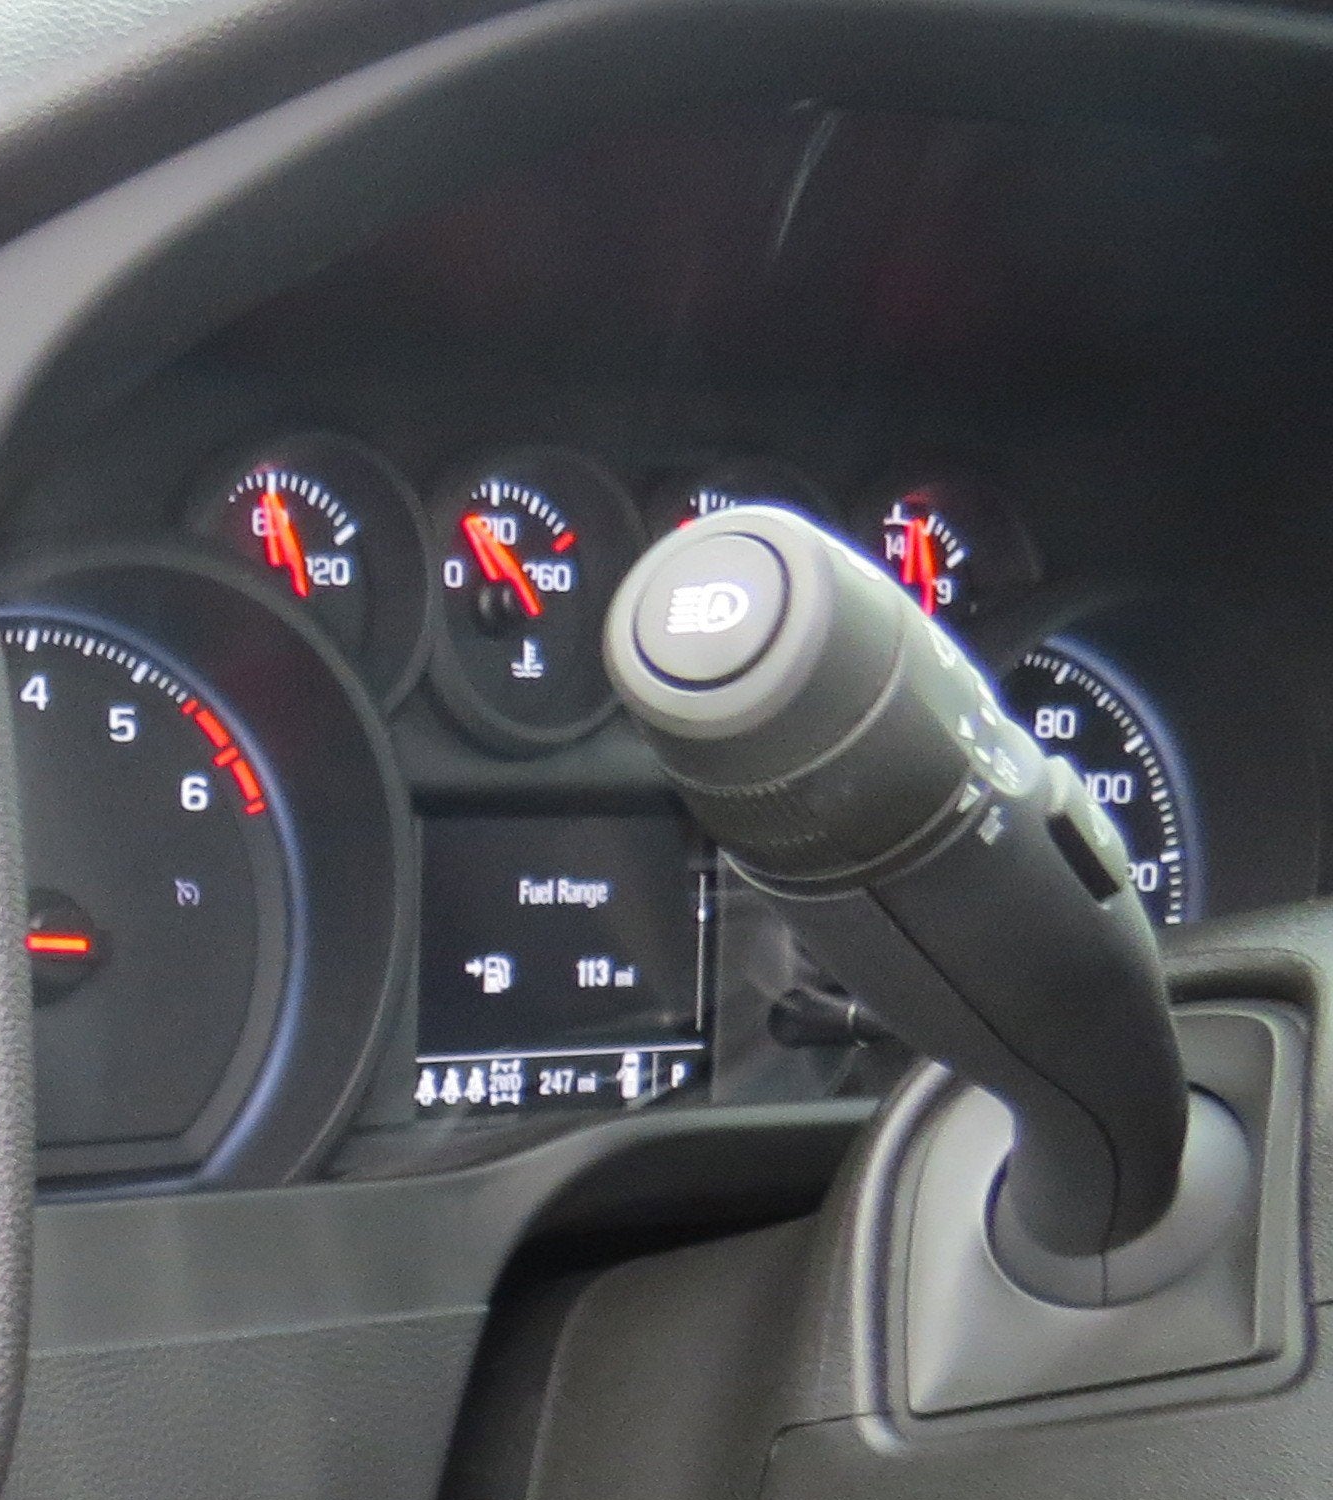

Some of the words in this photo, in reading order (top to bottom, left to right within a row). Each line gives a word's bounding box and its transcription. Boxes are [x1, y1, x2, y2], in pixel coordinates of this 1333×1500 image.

[443, 558, 464, 589] 0
[19, 673, 49, 711] 4
[108, 706, 137, 743] 5
[1034, 707, 1077, 740] 80
[180, 775, 209, 812] 6
[518, 879, 553, 905] Fuel
[558, 879, 608, 908] Range
[576, 958, 610, 988] 113
[539, 1069, 574, 1096] 247
[671, 1062, 686, 1089] P
